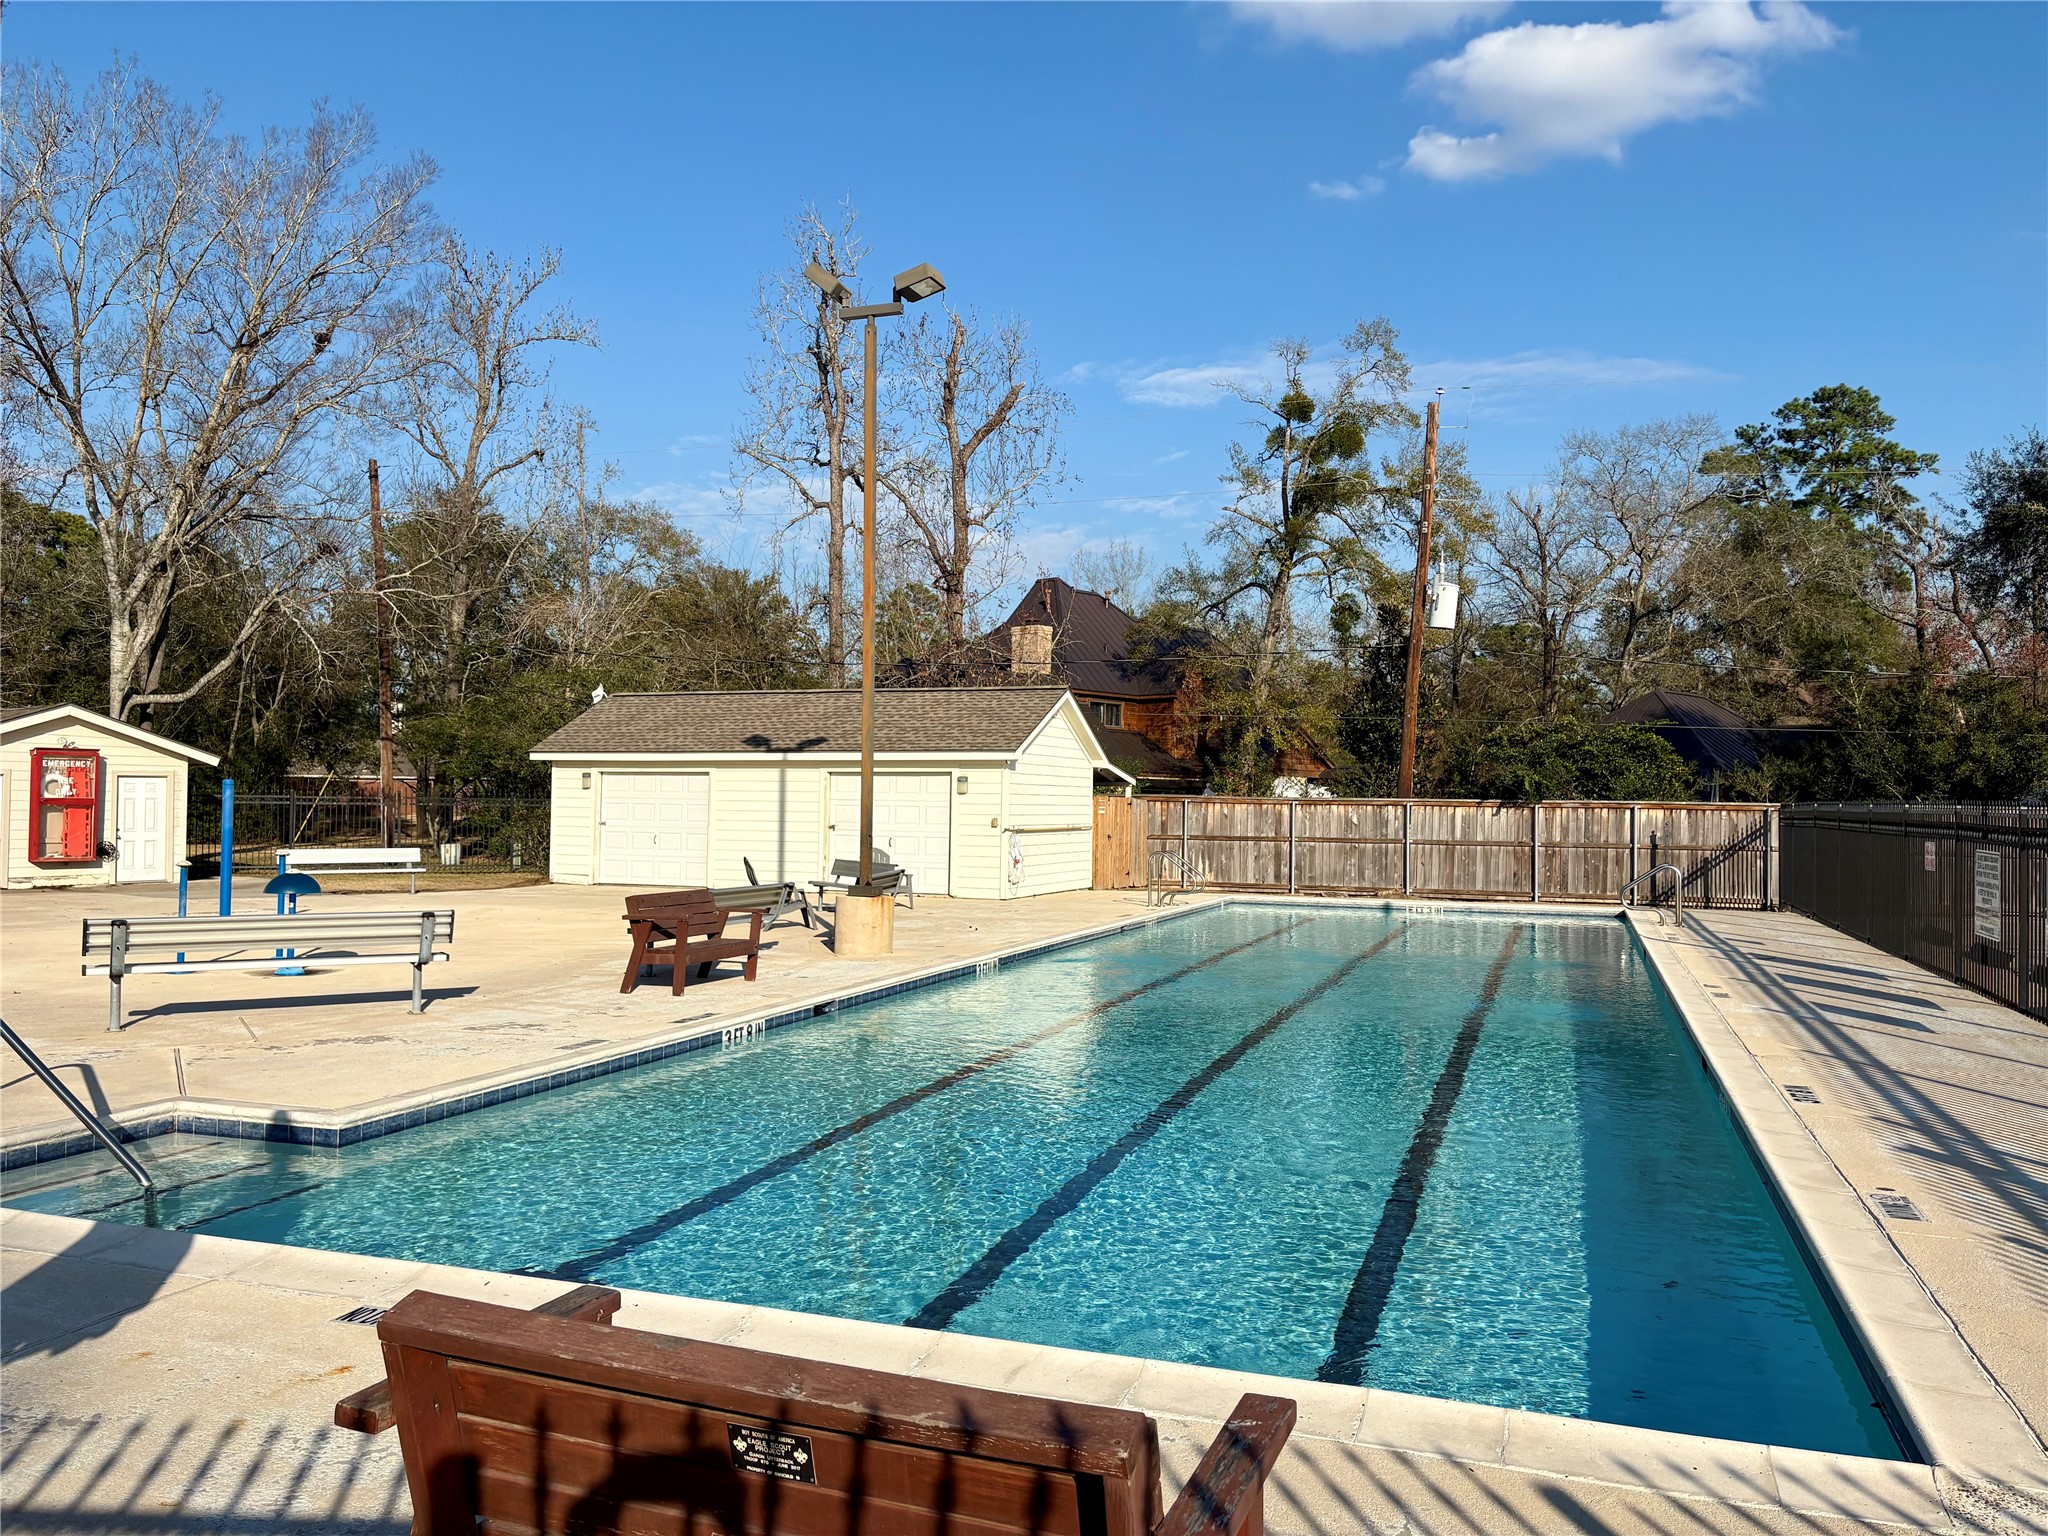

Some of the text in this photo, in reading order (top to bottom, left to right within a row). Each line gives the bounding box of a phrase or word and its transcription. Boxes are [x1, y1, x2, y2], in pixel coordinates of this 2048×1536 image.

[42, 759, 91, 768] EMERGENCY
[741, 1428, 750, 1436] BOY
[751, 1431, 768, 1440] SCOUTS
[777, 1436, 796, 1445] AMERICA
[747, 1437, 792, 1452] EAGLE SCOUT
[754, 1445, 786, 1457] PROJECT
[743, 1455, 759, 1463] TROOP
[746, 1465, 766, 1474] PROPERTY
